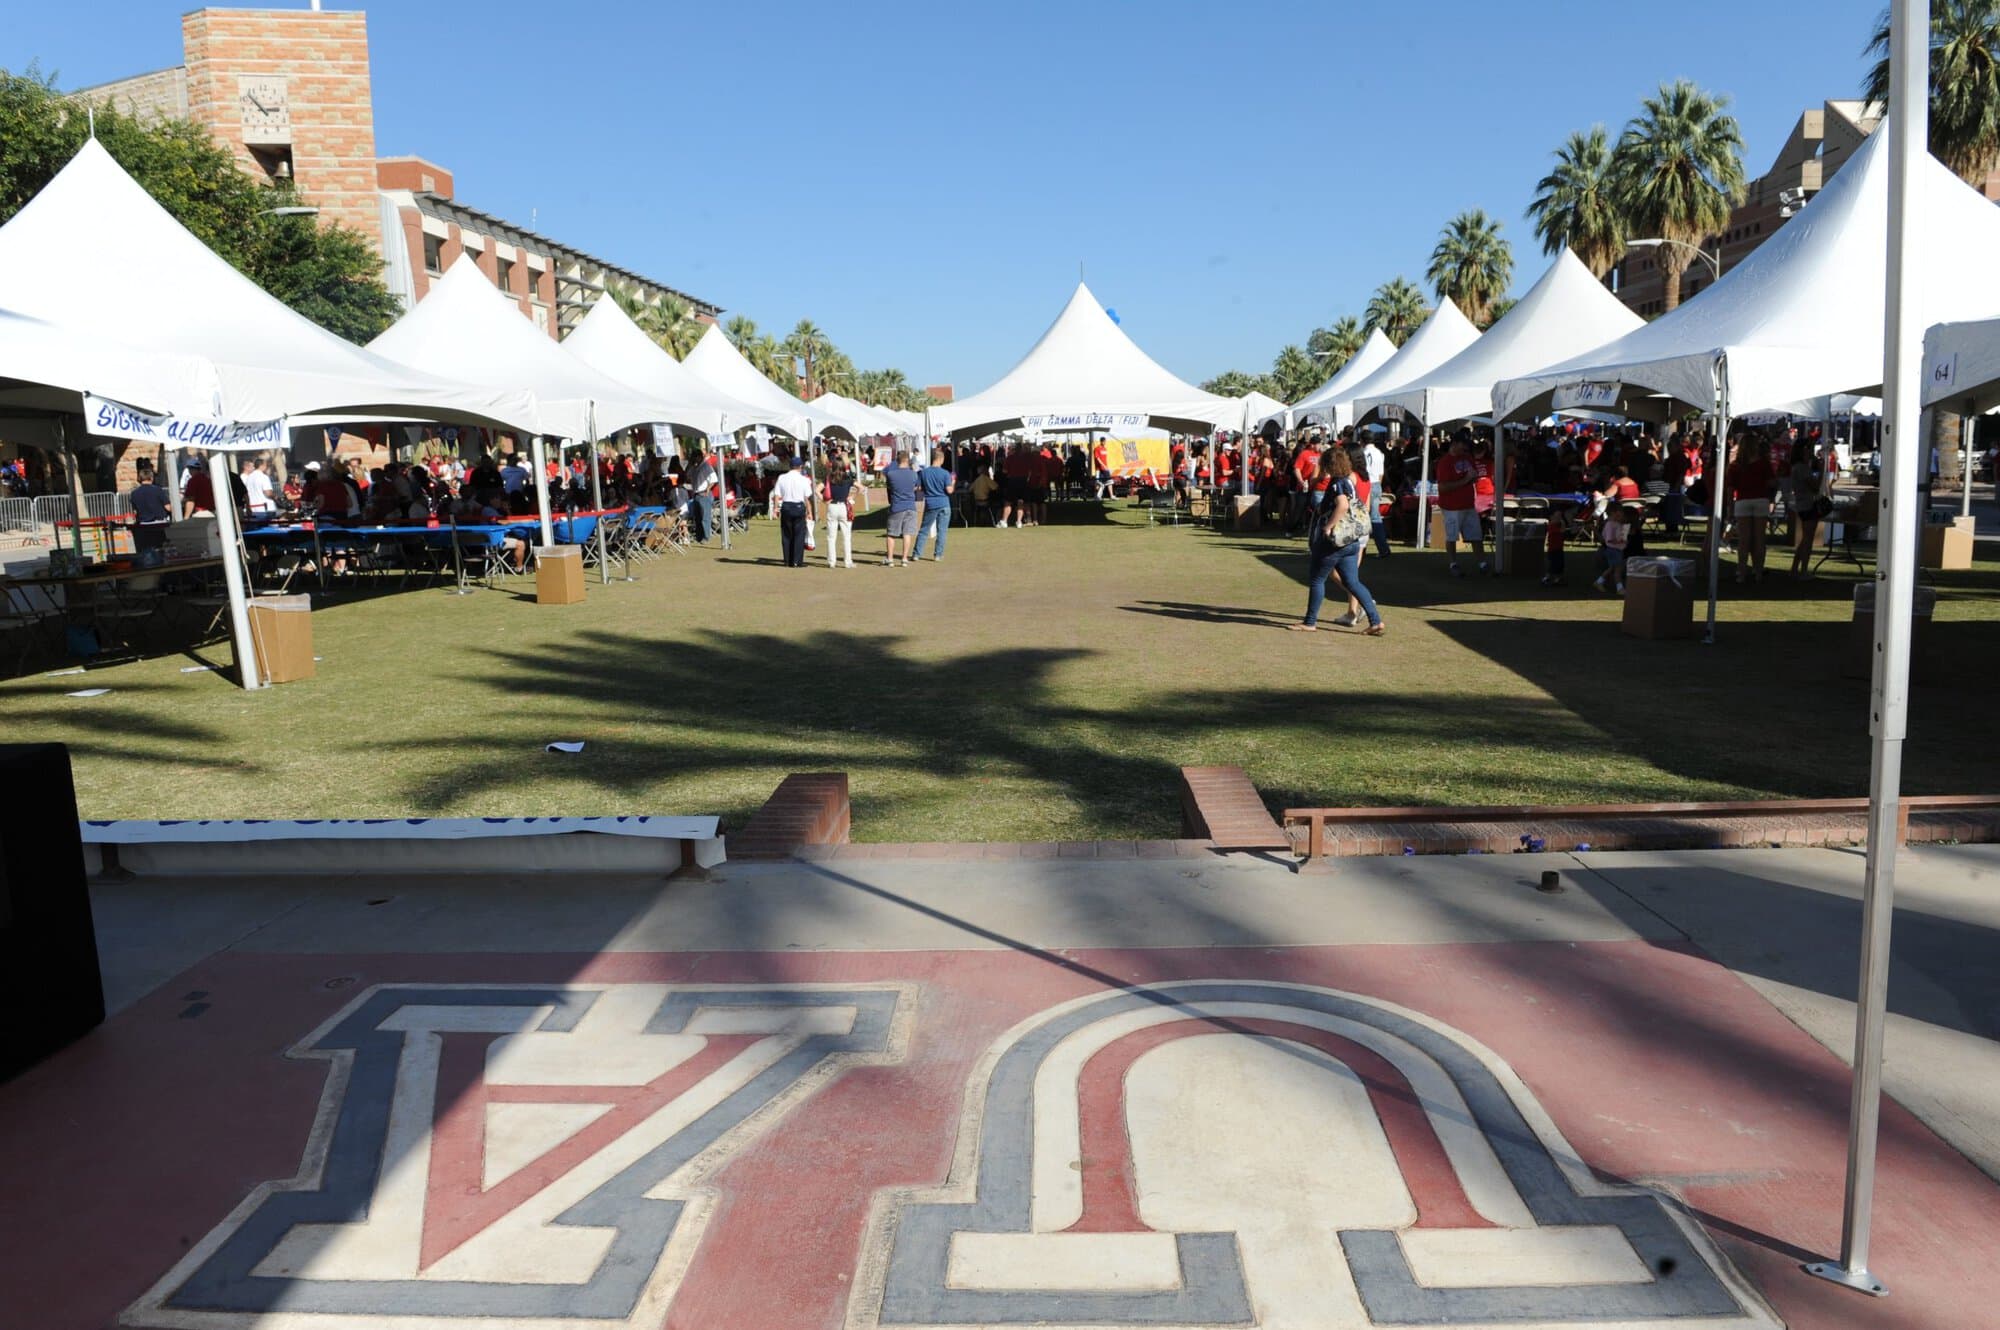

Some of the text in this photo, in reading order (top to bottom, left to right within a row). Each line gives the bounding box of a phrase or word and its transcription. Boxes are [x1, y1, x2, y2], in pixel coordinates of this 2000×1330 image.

[1934, 363, 1949, 381] 64
[97, 404, 157, 437] SIGMA
[168, 420, 226, 445] ALPHA
[1048, 416, 1081, 426] GAMMA
[1086, 415, 1113, 425] DELTA
